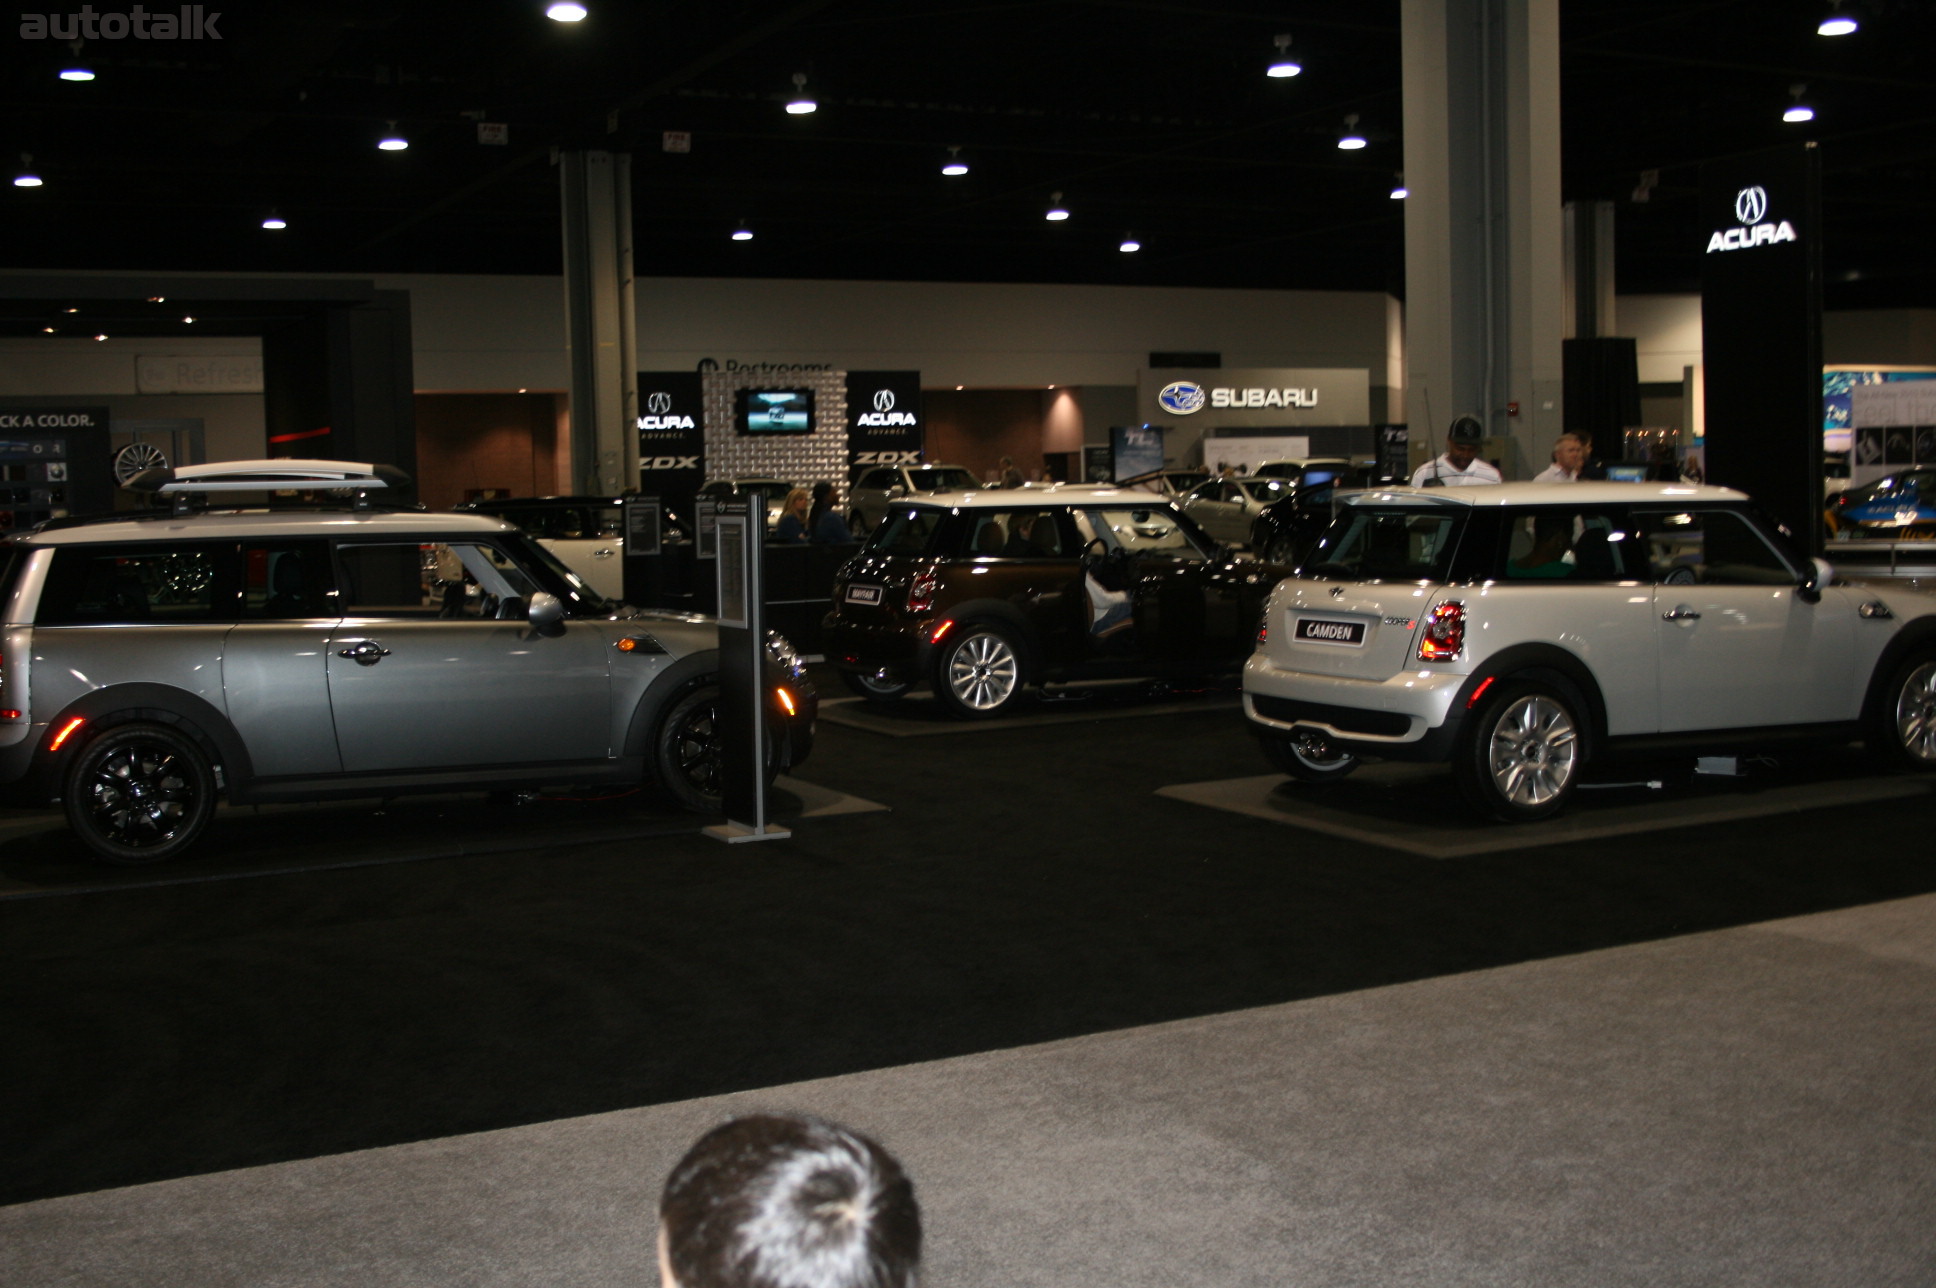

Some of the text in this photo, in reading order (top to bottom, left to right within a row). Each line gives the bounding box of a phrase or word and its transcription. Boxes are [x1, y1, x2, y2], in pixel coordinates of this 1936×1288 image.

[1706, 220, 1797, 254] ACURA
[1211, 388, 1318, 408] SUBARU
[22, 415, 35, 428] A
[37, 414, 95, 428] COLOR.
[857, 412, 916, 426] ACURA
[853, 451, 920, 465] ZDX
[1306, 622, 1353, 641] CAMDEN
[1406, 620, 1416, 630] S
